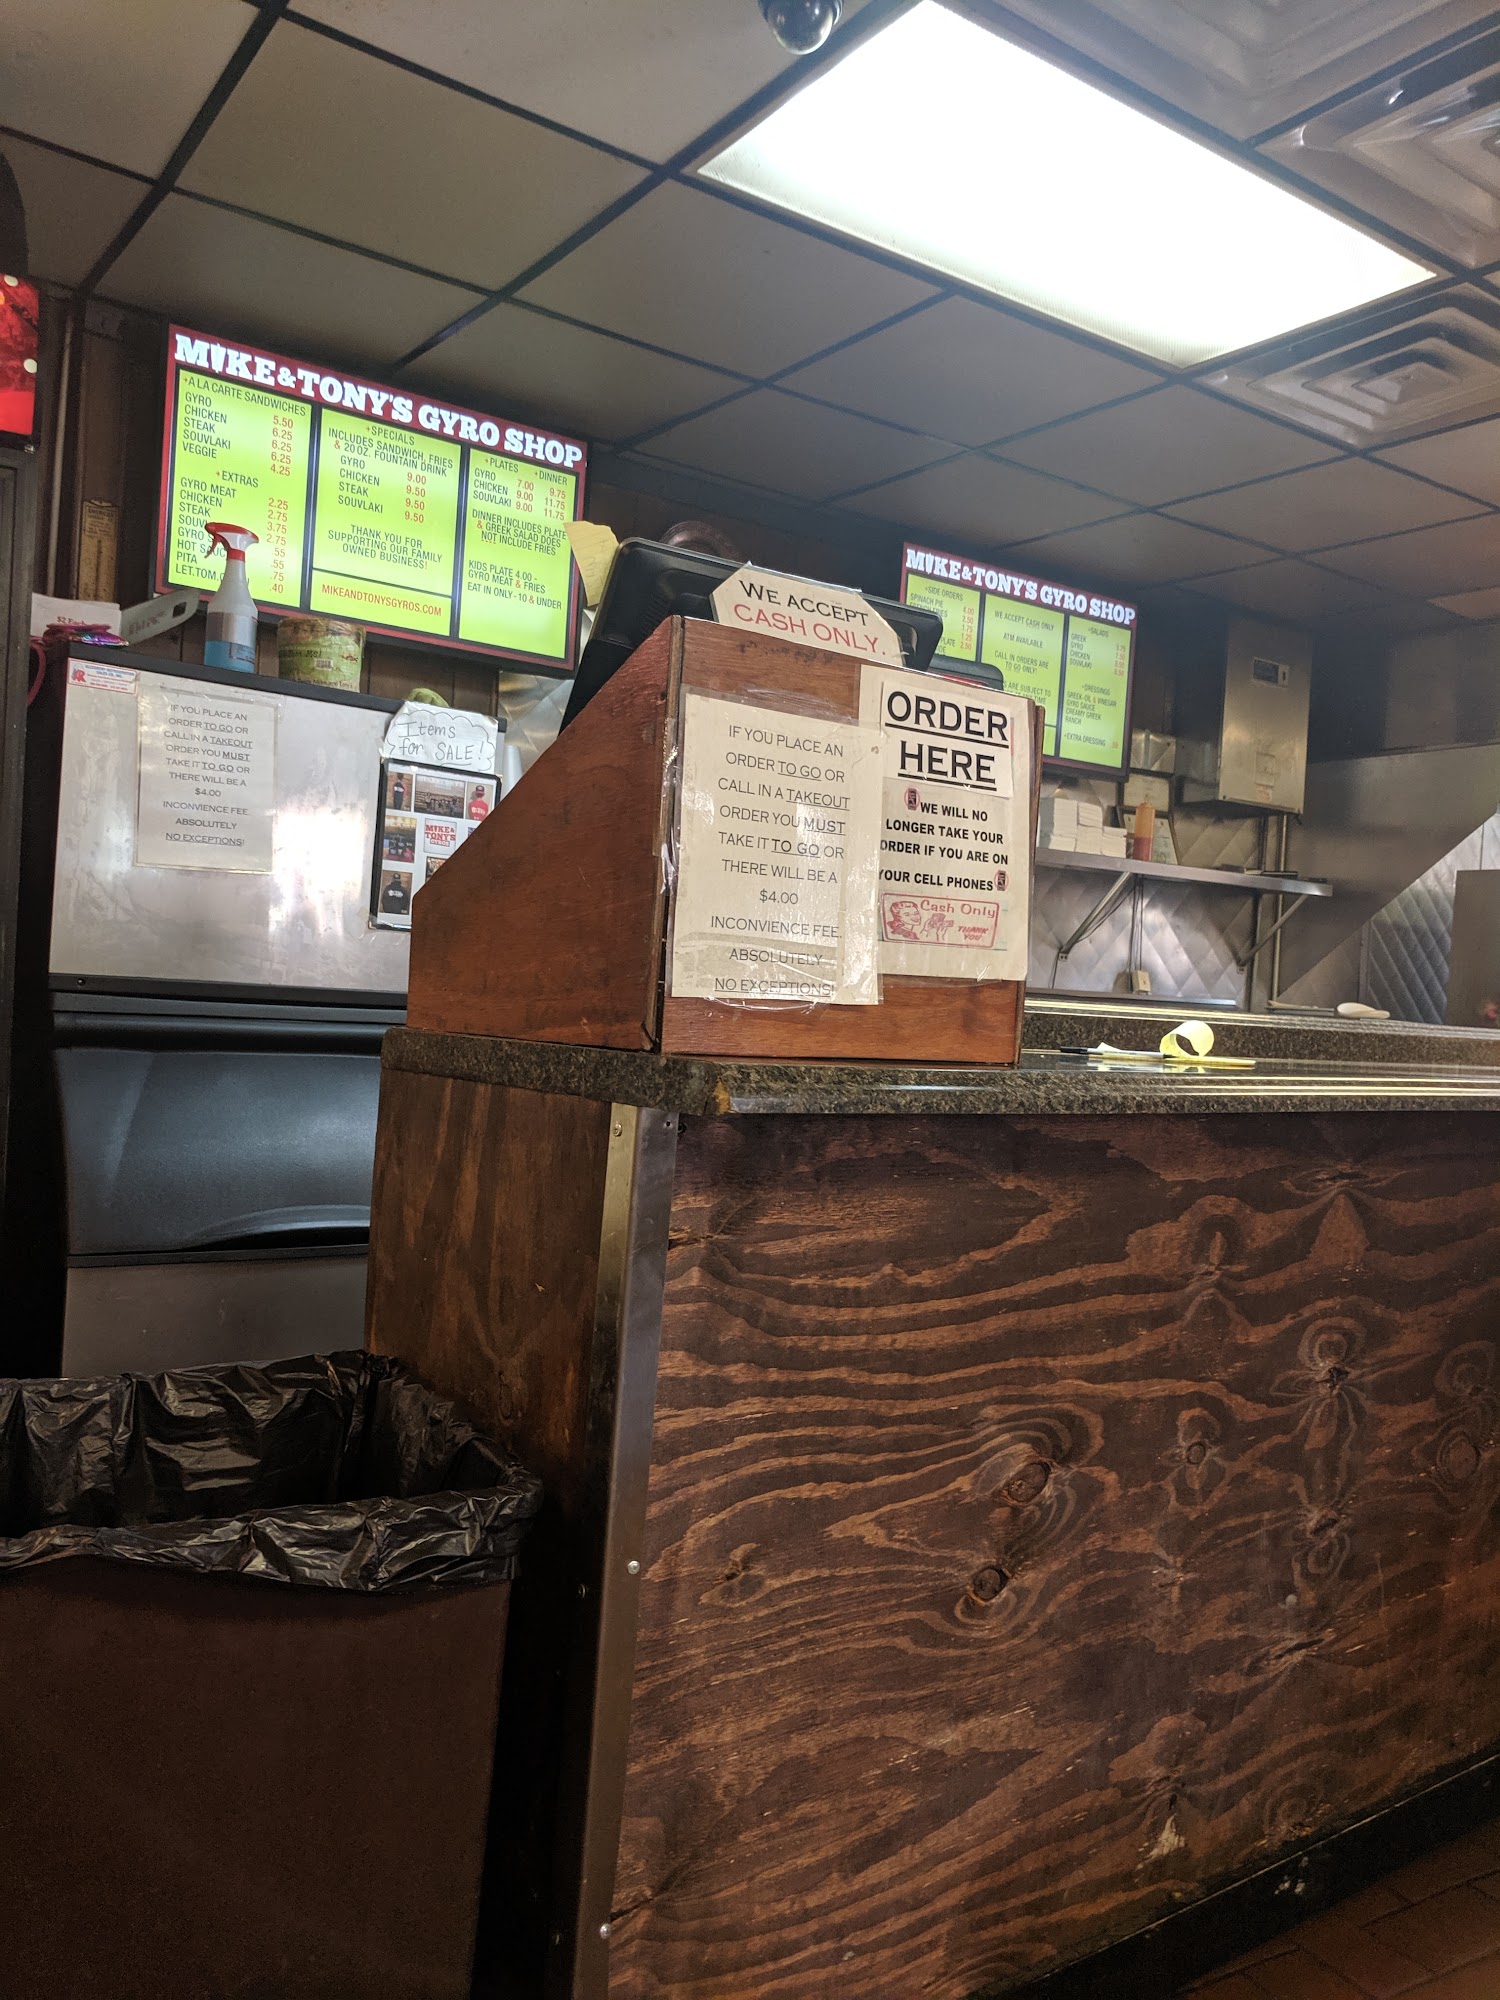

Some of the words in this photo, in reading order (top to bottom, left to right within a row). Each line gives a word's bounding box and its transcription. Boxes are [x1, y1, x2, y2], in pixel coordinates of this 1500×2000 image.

[185, 391, 212, 407] GYRO
[273, 415, 293, 429] 5.50
[245, 391, 306, 416] SANDWICHES
[185, 405, 227, 424] CHICKEN
[273, 428, 292, 440] 6.25
[184, 417, 215, 433] STEAK
[272, 439, 292, 452] 6.25
[371, 426, 415, 445] SPECIALS
[418, 405, 500, 446] GYRO
[504, 428, 582, 468] SHOP
[183, 430, 230, 450] SOUVLAKI
[271, 452, 291, 464] 6.25
[329, 428, 373, 448] INCLUDES
[429, 454, 453, 468] FRIES
[182, 441, 216, 459] VEGGIE
[271, 464, 290, 476] 4.25
[375, 452, 417, 471] FOUNTAIN
[421, 462, 447, 477] DRINK
[222, 471, 259, 488] EXTRAS
[341, 455, 365, 469] GYRO
[407, 472, 426, 485] 9.00
[475, 468, 496, 480] GYRO
[490, 458, 518, 473] PLATES
[539, 471, 567, 486] DINNER
[340, 468, 380, 486] CHICKEN
[407, 485, 425, 497] 9.50
[474, 479, 508, 495] CHICKEN
[181, 477, 207, 491] GYRO
[211, 484, 237, 498] MEAT
[268, 498, 288, 510] 2.25
[339, 482, 368, 497] STEAK
[406, 498, 424, 510] 9.50
[473, 491, 511, 507] SOUVLAKI
[180, 489, 222, 507] CHICKEN
[268, 510, 287, 522] 2.75
[338, 495, 383, 514] SOUVLAKI
[405, 511, 424, 523] 9.50
[179, 502, 211, 517] STEAK
[267, 522, 286, 534] 3.75
[472, 509, 505, 525] DINNER
[504, 517, 541, 534] INCLUDES
[178, 526, 204, 540] GYRO
[351, 524, 381, 540] THANK
[385, 532, 401, 544] YOU
[405, 538, 422, 549] FOR
[486, 522, 511, 536] GREEK
[178, 539, 196, 551] HOT
[328, 530, 386, 551] SUPPORTING
[391, 544, 408, 555] OUR
[412, 549, 442, 563] FAMILY
[343, 543, 376, 558] OWNED
[500, 535, 532, 550] INCLUDE
[177, 552, 197, 564] PITA
[322, 584, 441, 616] MIKEANDTONYSGYROS.COM
[739, 580, 780, 606] WE
[787, 595, 868, 626] ACCEPT
[911, 594, 934, 605] SPINACH
[935, 599, 943, 608] PIE
[928, 586, 940, 594] SIDE
[942, 590, 963, 601] ORDERS
[1040, 587, 1087, 614] GYRO
[1089, 599, 1136, 625] SHOP
[734, 603, 807, 636] CASH
[813, 623, 886, 655] ONLY.
[1004, 612, 1024, 623] ACCEPT
[1026, 618, 1040, 626] CASH
[1041, 622, 1054, 631] ONLY
[1003, 633, 1014, 641] ATM
[1016, 636, 1043, 648] AVAILABLE
[995, 651, 1007, 659] CALL
[1016, 654, 1037, 666] ORDERS
[1039, 660, 1048, 669] ARE
[1008, 681, 1018, 689] ARE
[1020, 684, 1043, 696] SUBJECT
[1044, 688, 1051, 696] TO
[1036, 695, 1046, 704] TIME
[169, 718, 202, 728] ORDER
[203, 709, 232, 719] PLACE
[888, 691, 1008, 742] ORDER
[398, 721, 455, 738] Items
[166, 745, 200, 755] ORDER
[210, 736, 253, 748] TAKEOUT
[400, 738, 423, 755] for
[729, 725, 741, 738] IF
[744, 728, 772, 744] YOU
[777, 734, 821, 753] PLACE
[824, 744, 843, 757] AN
[726, 752, 775, 771] ORDER
[778, 761, 796, 775] TO
[800, 766, 821, 779] GO
[825, 769, 845, 782] OR
[900, 740, 995, 784] HERE
[169, 772, 200, 781] THERE
[202, 776, 224, 784] WILL
[718, 778, 755, 795] CALL
[758, 784, 771, 797] IN
[786, 789, 850, 809] TAKEOUT
[164, 801, 229, 813] INCONVIENCE
[921, 802, 938, 814] WE
[942, 805, 968, 819] WILL
[972, 810, 987, 821] NO
[176, 818, 237, 829] ABSOLUTELY
[720, 805, 769, 823] ORDER
[772, 813, 799, 827] YOU
[805, 818, 845, 834] MUST
[425, 832, 456, 841] TONY'S
[886, 819, 934, 835] LONGER
[939, 826, 968, 839] TAKE
[973, 830, 1003, 844] YOUR
[719, 832, 754, 848] TAKE
[758, 837, 769, 849] IT
[772, 839, 792, 852] TO
[824, 845, 844, 858] OR
[881, 840, 920, 855] ORDER
[924, 845, 935, 856] IF
[939, 847, 963, 859] YOU
[967, 851, 989, 862] ARE
[993, 854, 1008, 865] ON
[722, 859, 767, 875] THERE
[770, 865, 804, 880] WILL
[807, 869, 825, 882] BE
[914, 873, 943, 886] CELL
[947, 877, 993, 891] PHONES
[760, 888, 798, 904] $4.00
[921, 900, 954, 913] Cash
[961, 903, 995, 918] Only
[711, 916, 810, 936] INCONVIENCE
[729, 948, 822, 965] ABSOLUTELY
[715, 978, 736, 991] NO
[741, 979, 834, 996] EXCEPTIONS!
